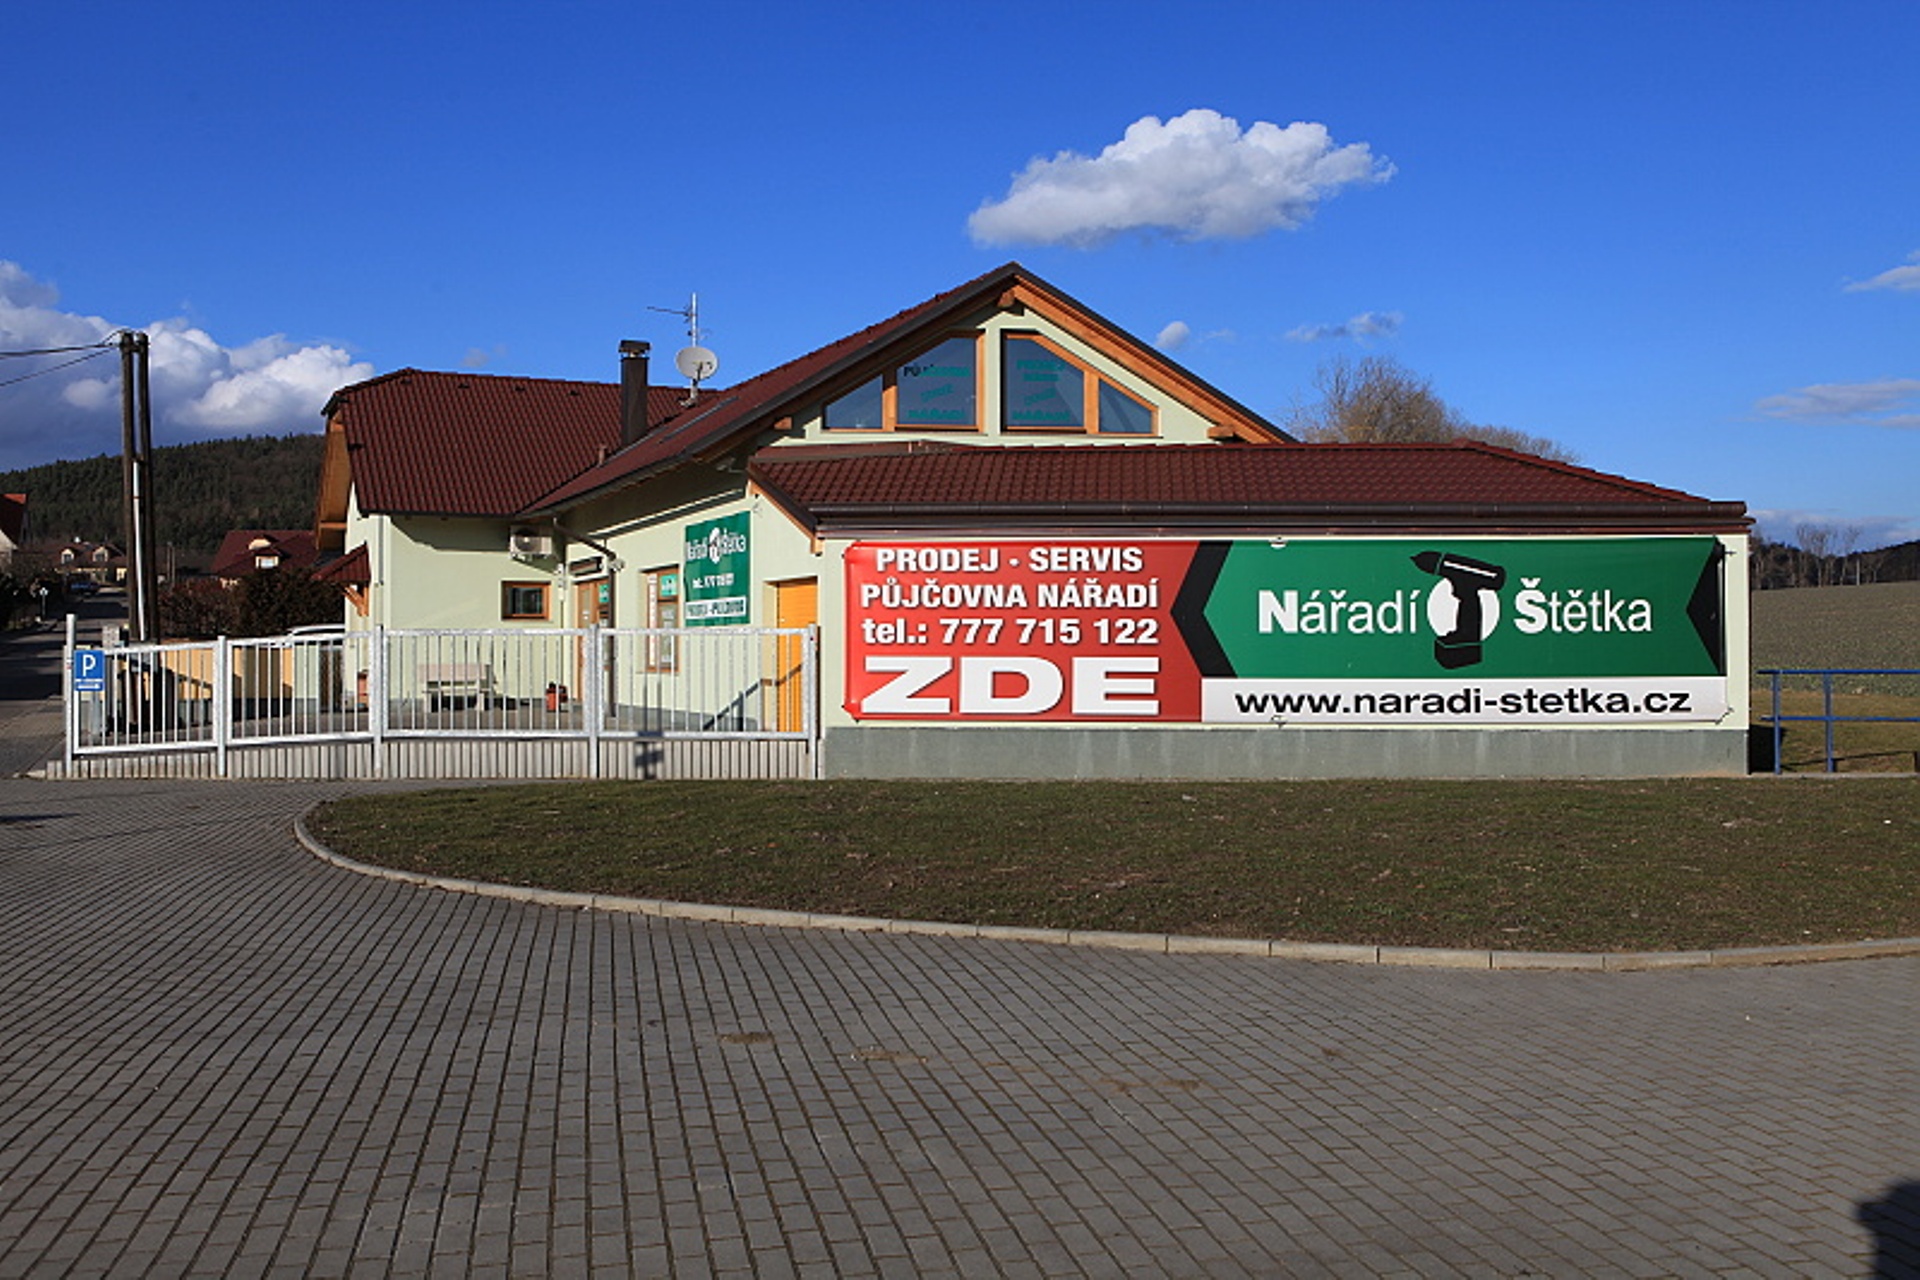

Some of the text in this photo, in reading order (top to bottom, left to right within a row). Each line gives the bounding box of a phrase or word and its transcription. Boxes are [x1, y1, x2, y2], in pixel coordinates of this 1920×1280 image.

[876, 547, 1143, 572] PRODEJ SERVIS
[860, 577, 1159, 608] PŮJČOVNA NÁŘADÍ
[1258, 577, 1653, 634] Nářadí Štětka
[862, 618, 1160, 645] tel.: 777 715 122
[82, 654, 96, 677] P
[860, 656, 1160, 715] ZDE
[1235, 687, 1692, 714] www.naradi-stetka.cz
